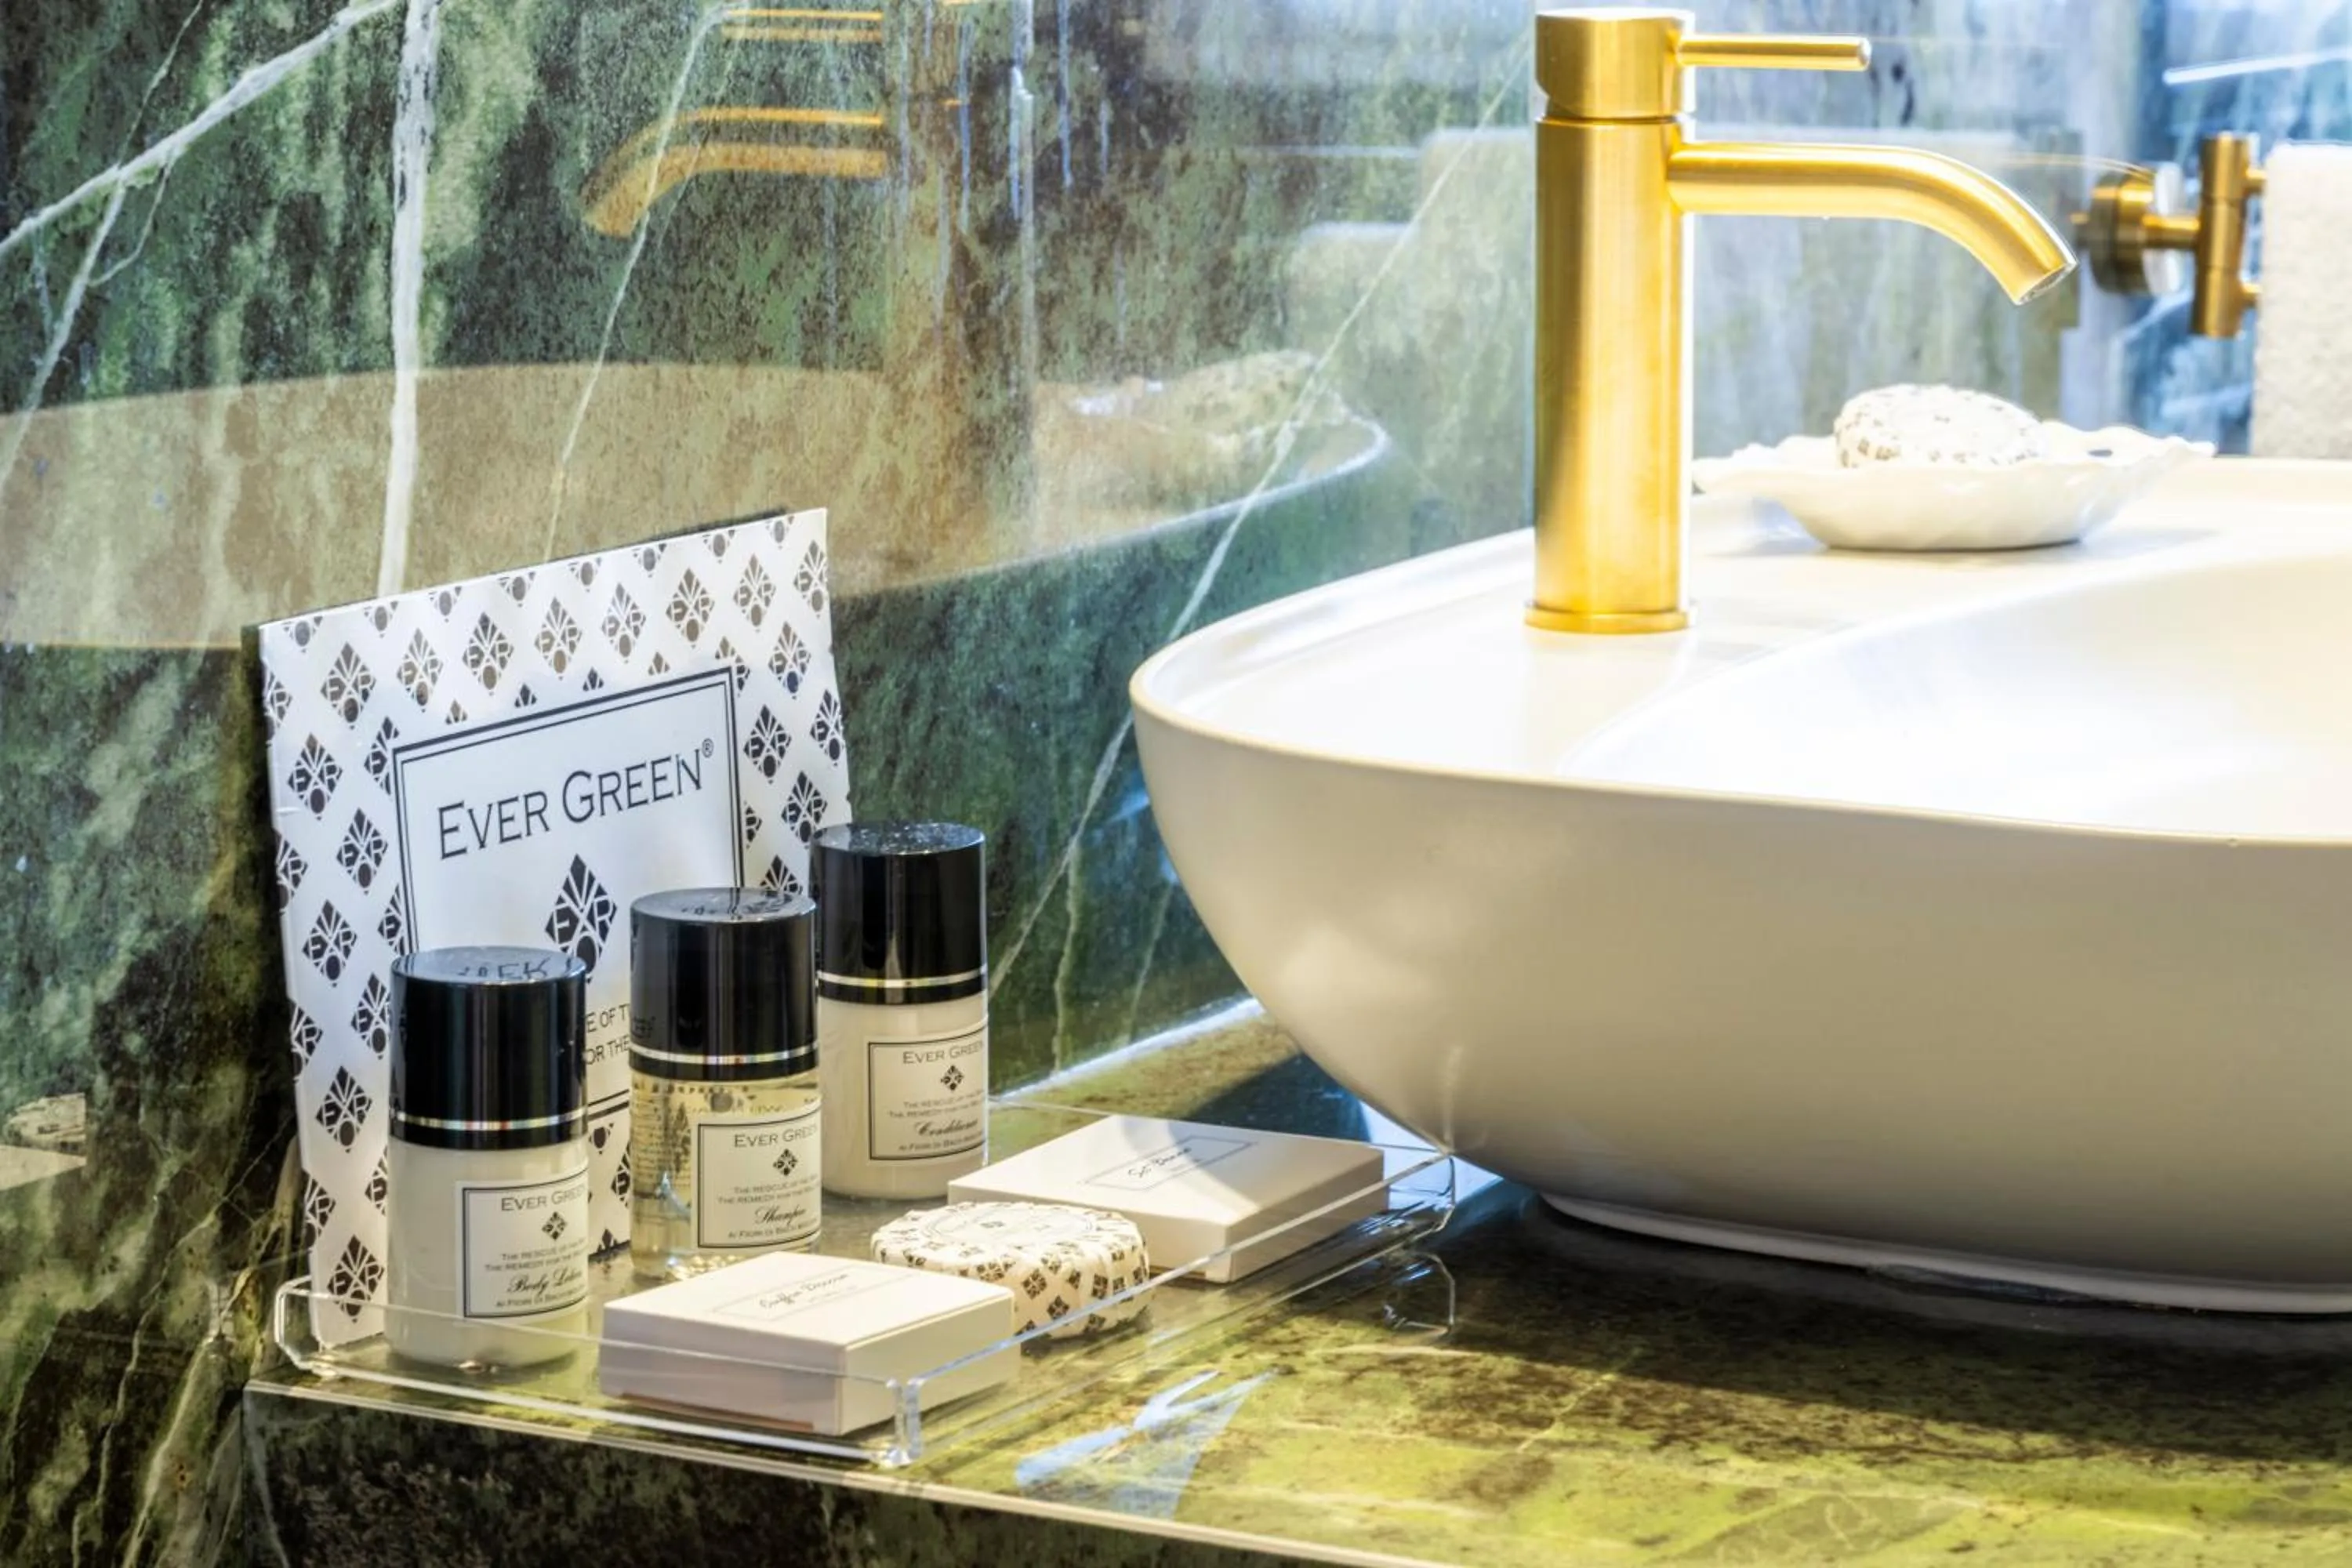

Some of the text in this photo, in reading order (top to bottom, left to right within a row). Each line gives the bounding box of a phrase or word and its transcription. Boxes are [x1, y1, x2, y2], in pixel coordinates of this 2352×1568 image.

[437, 790, 550, 861] EVER
[599, 1007, 615, 1028] OF
[586, 1044, 604, 1065] OR
[902, 1050, 945, 1065] EVER
[734, 1133, 779, 1148] EVER
[500, 1196, 548, 1212] EVER
